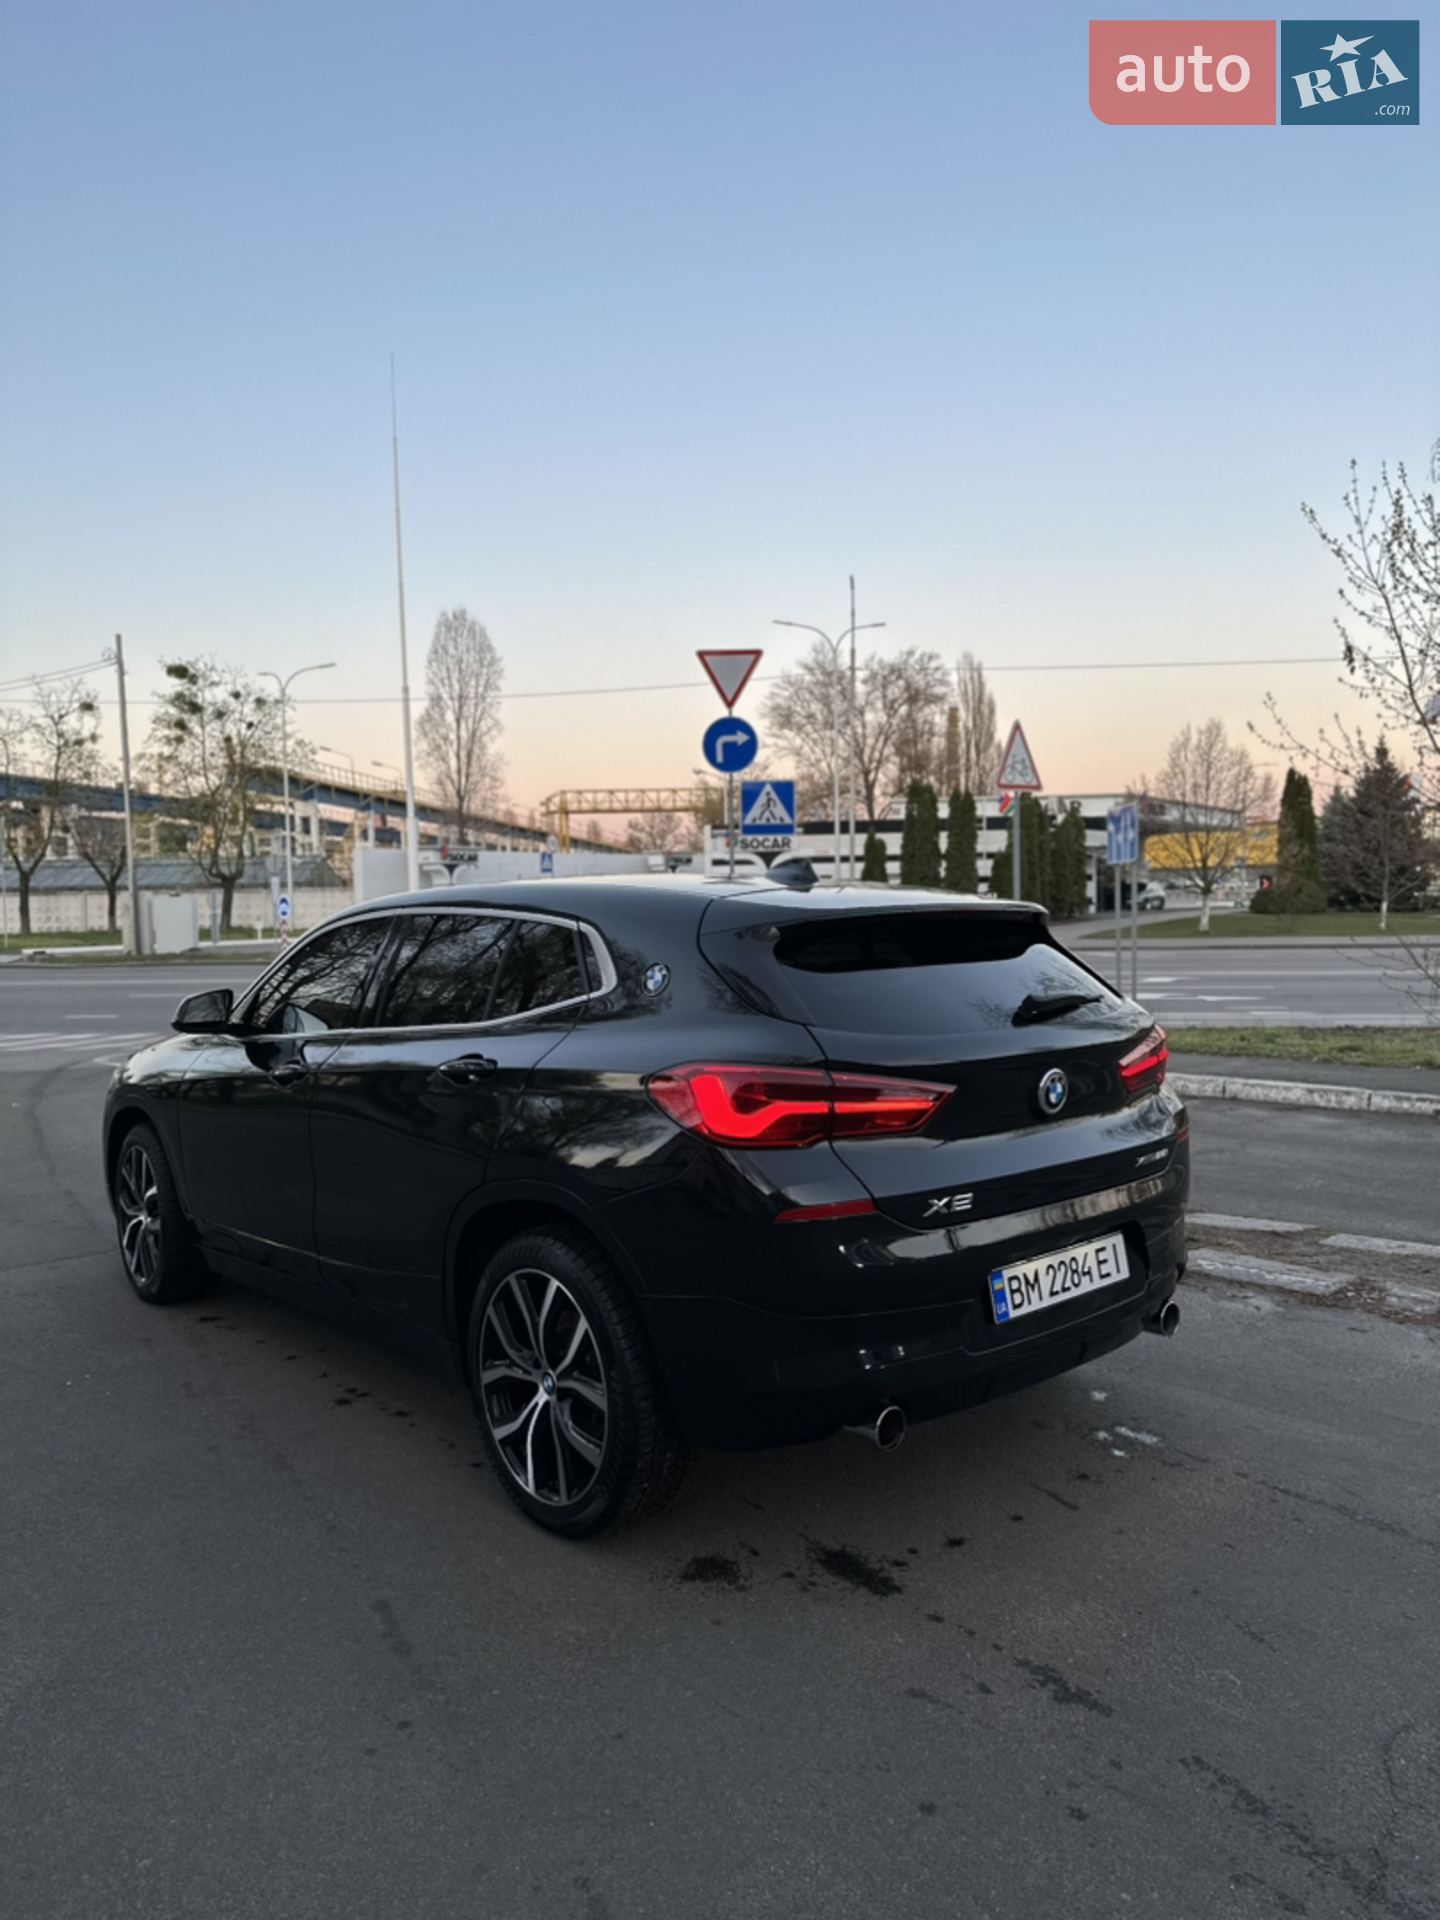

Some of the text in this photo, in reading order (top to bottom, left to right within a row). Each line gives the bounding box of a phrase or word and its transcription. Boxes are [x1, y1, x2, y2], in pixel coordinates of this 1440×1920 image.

[740, 837, 791, 849] SOCAR
[1007, 1267, 1043, 1310] BM
[1046, 1252, 1094, 1297] 2284
